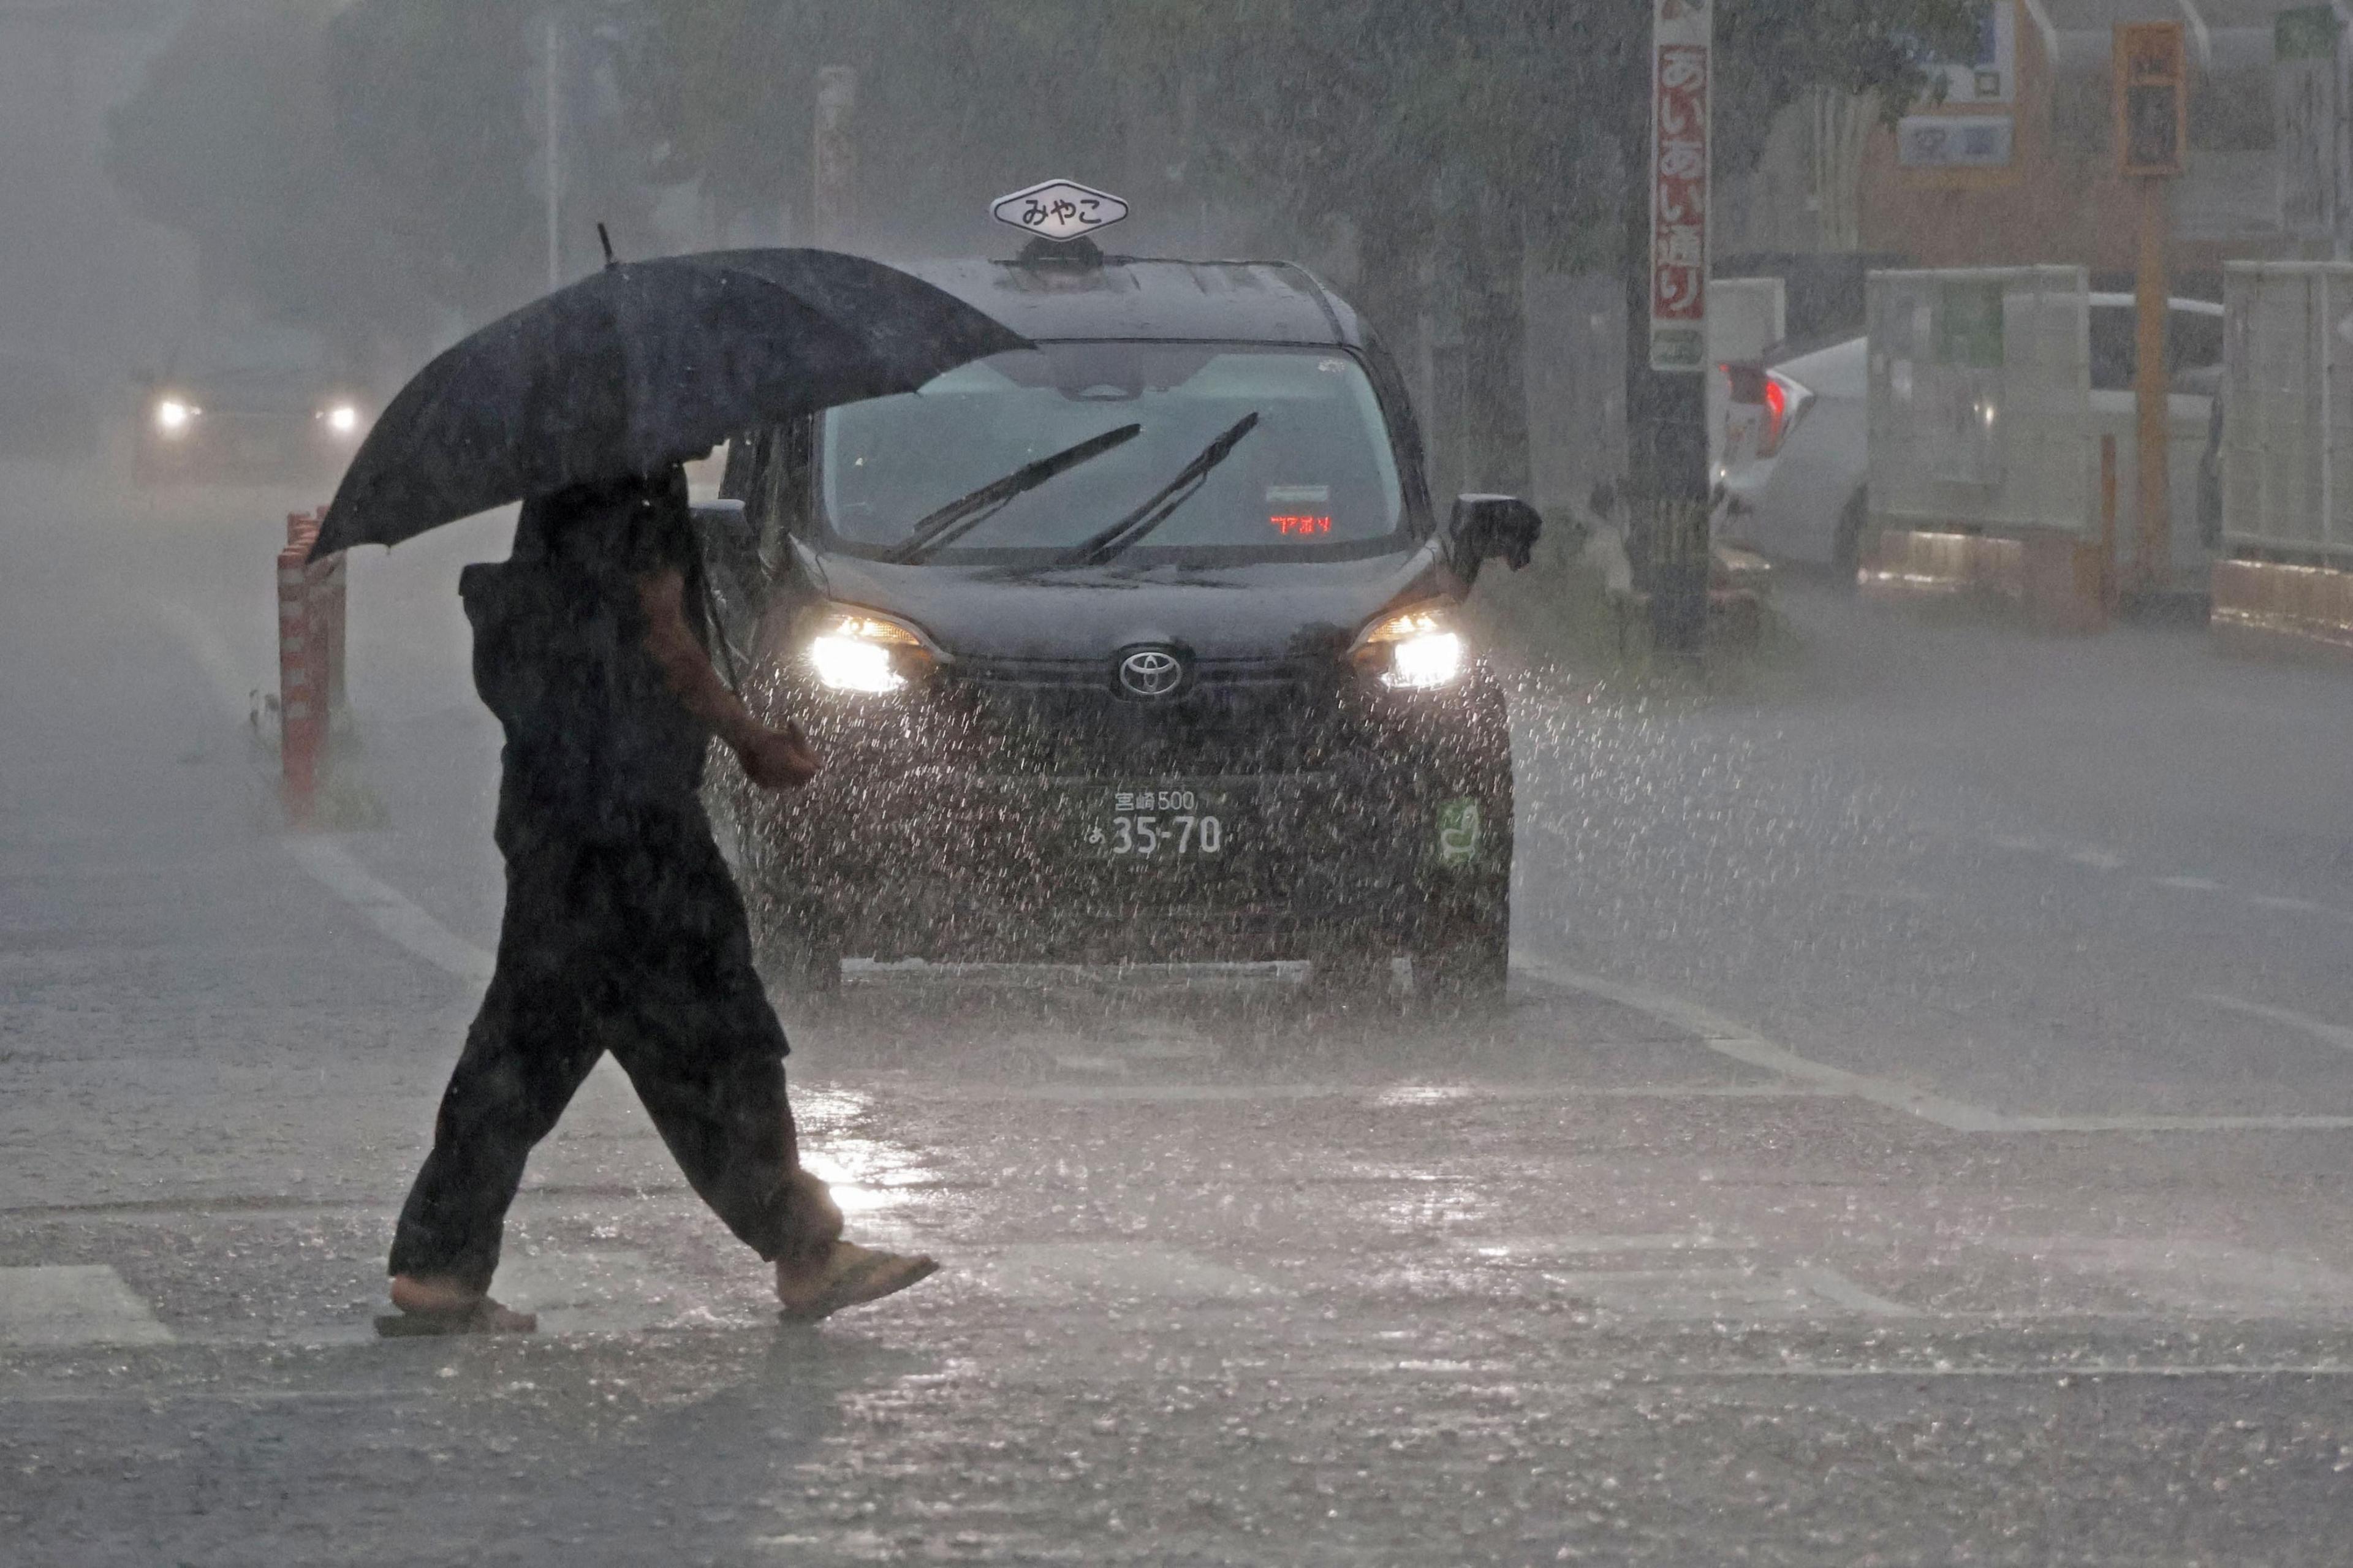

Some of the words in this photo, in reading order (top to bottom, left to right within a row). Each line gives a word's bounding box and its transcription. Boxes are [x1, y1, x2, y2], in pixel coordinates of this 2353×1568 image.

[1658, 51, 1705, 311] あいあい通り
[1023, 199, 1102, 225] みやこ
[1113, 816, 1220, 854] 35-70
